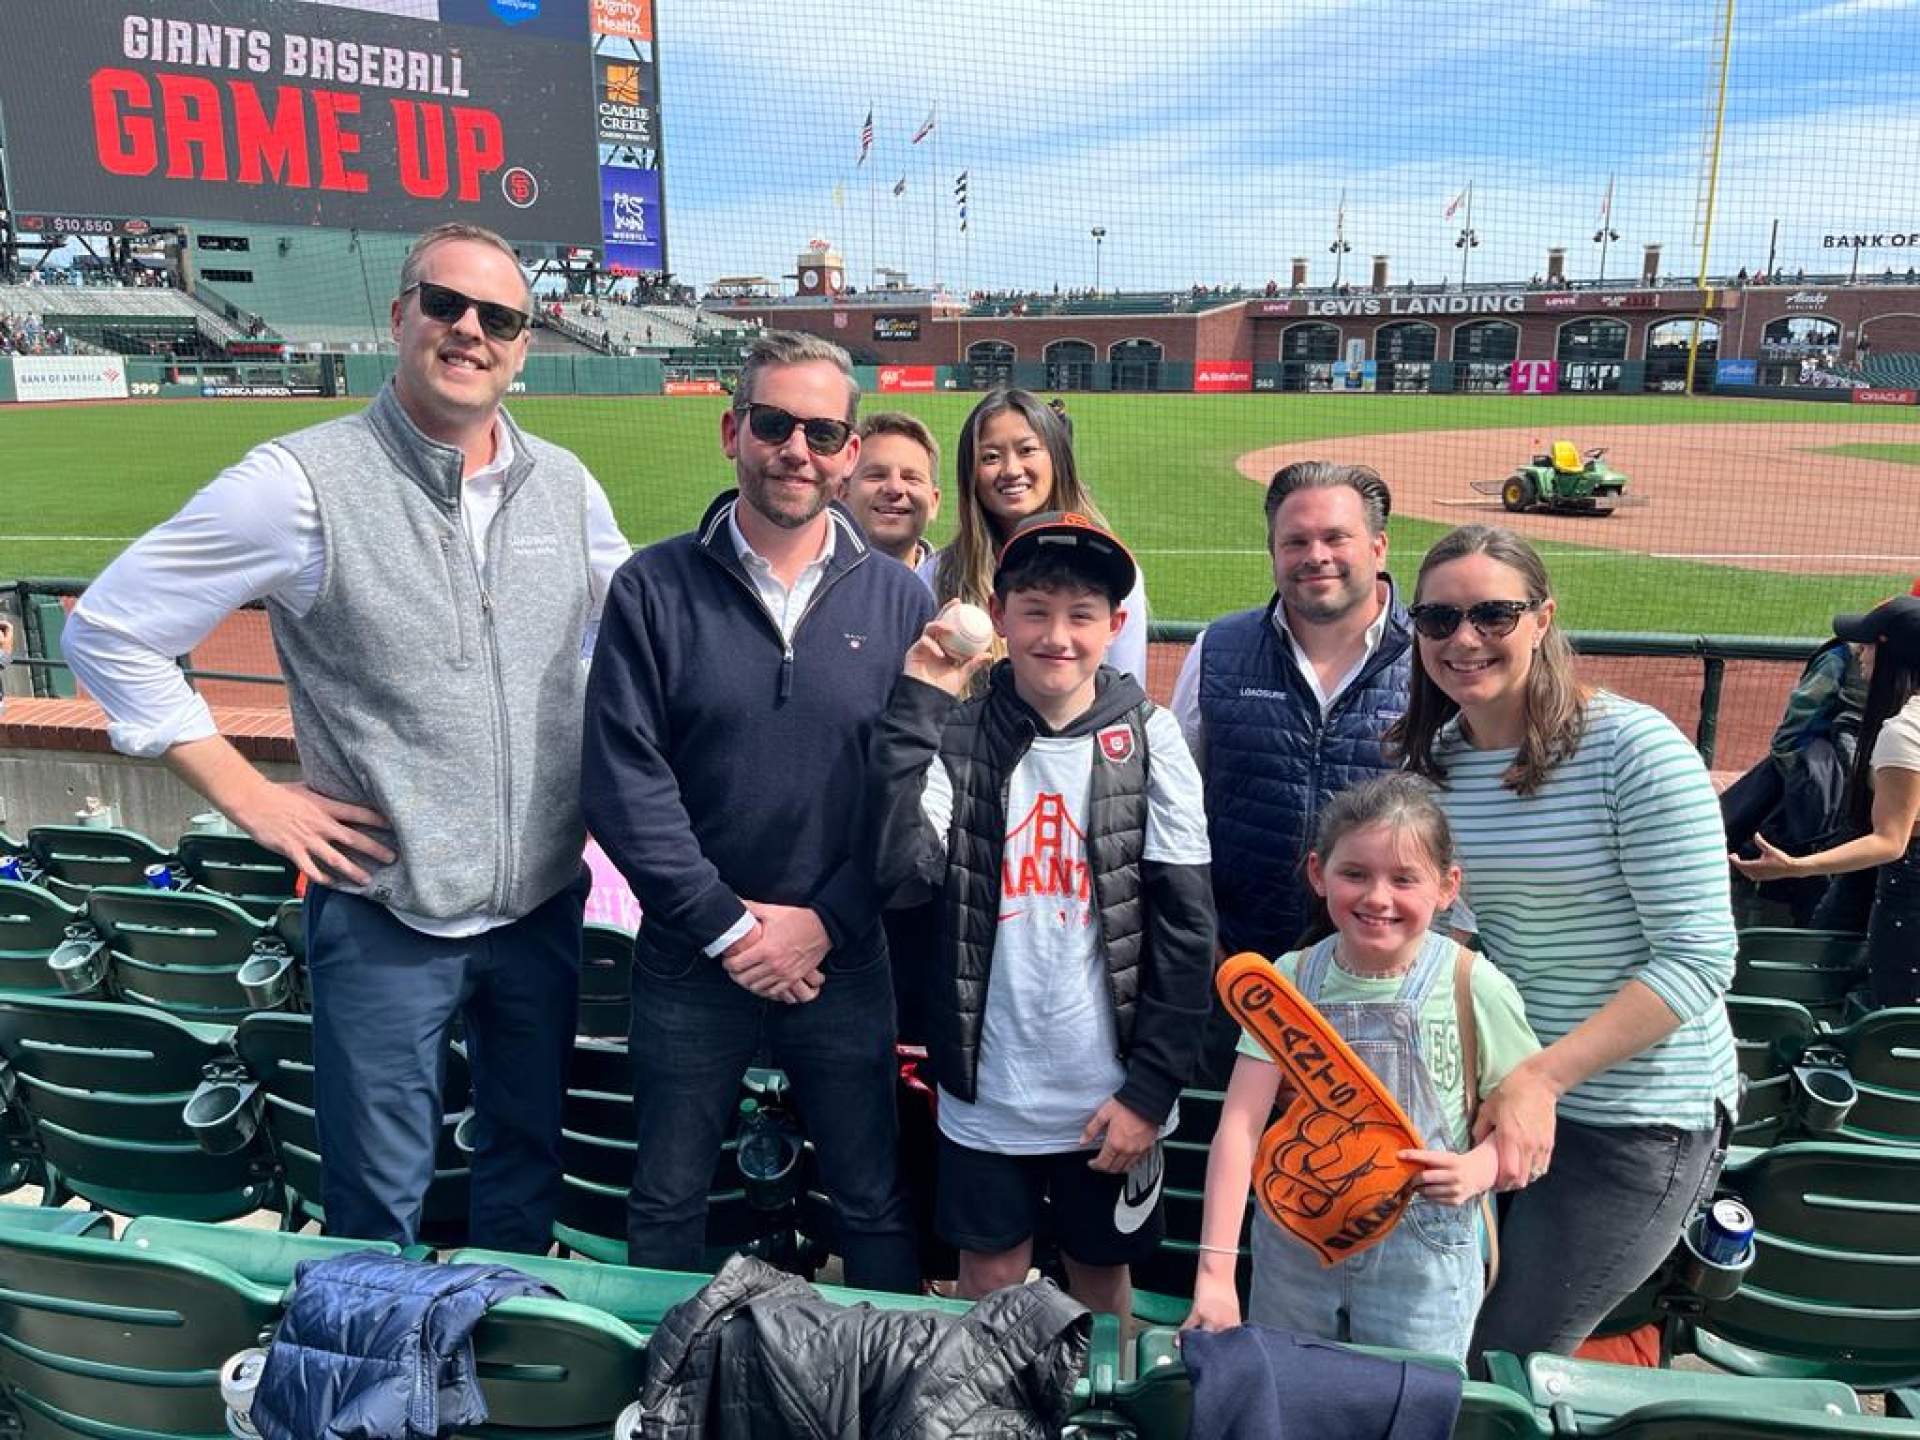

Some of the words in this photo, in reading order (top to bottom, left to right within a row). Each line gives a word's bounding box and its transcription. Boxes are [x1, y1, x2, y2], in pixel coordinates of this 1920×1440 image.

[123, 14, 271, 72] GIANTS
[284, 34, 469, 97] BASEBALL
[599, 103, 650, 121] CACHE
[601, 116, 648, 133] CREEK
[89, 68, 369, 193] GAME
[390, 98, 505, 202] UP
[1823, 234, 1882, 248] BANK
[1891, 233, 1920, 246] OF
[1390, 297, 1526, 314] LANDING
[131, 383, 160, 395] 399
[1240, 982, 1358, 1108] GIANTS
